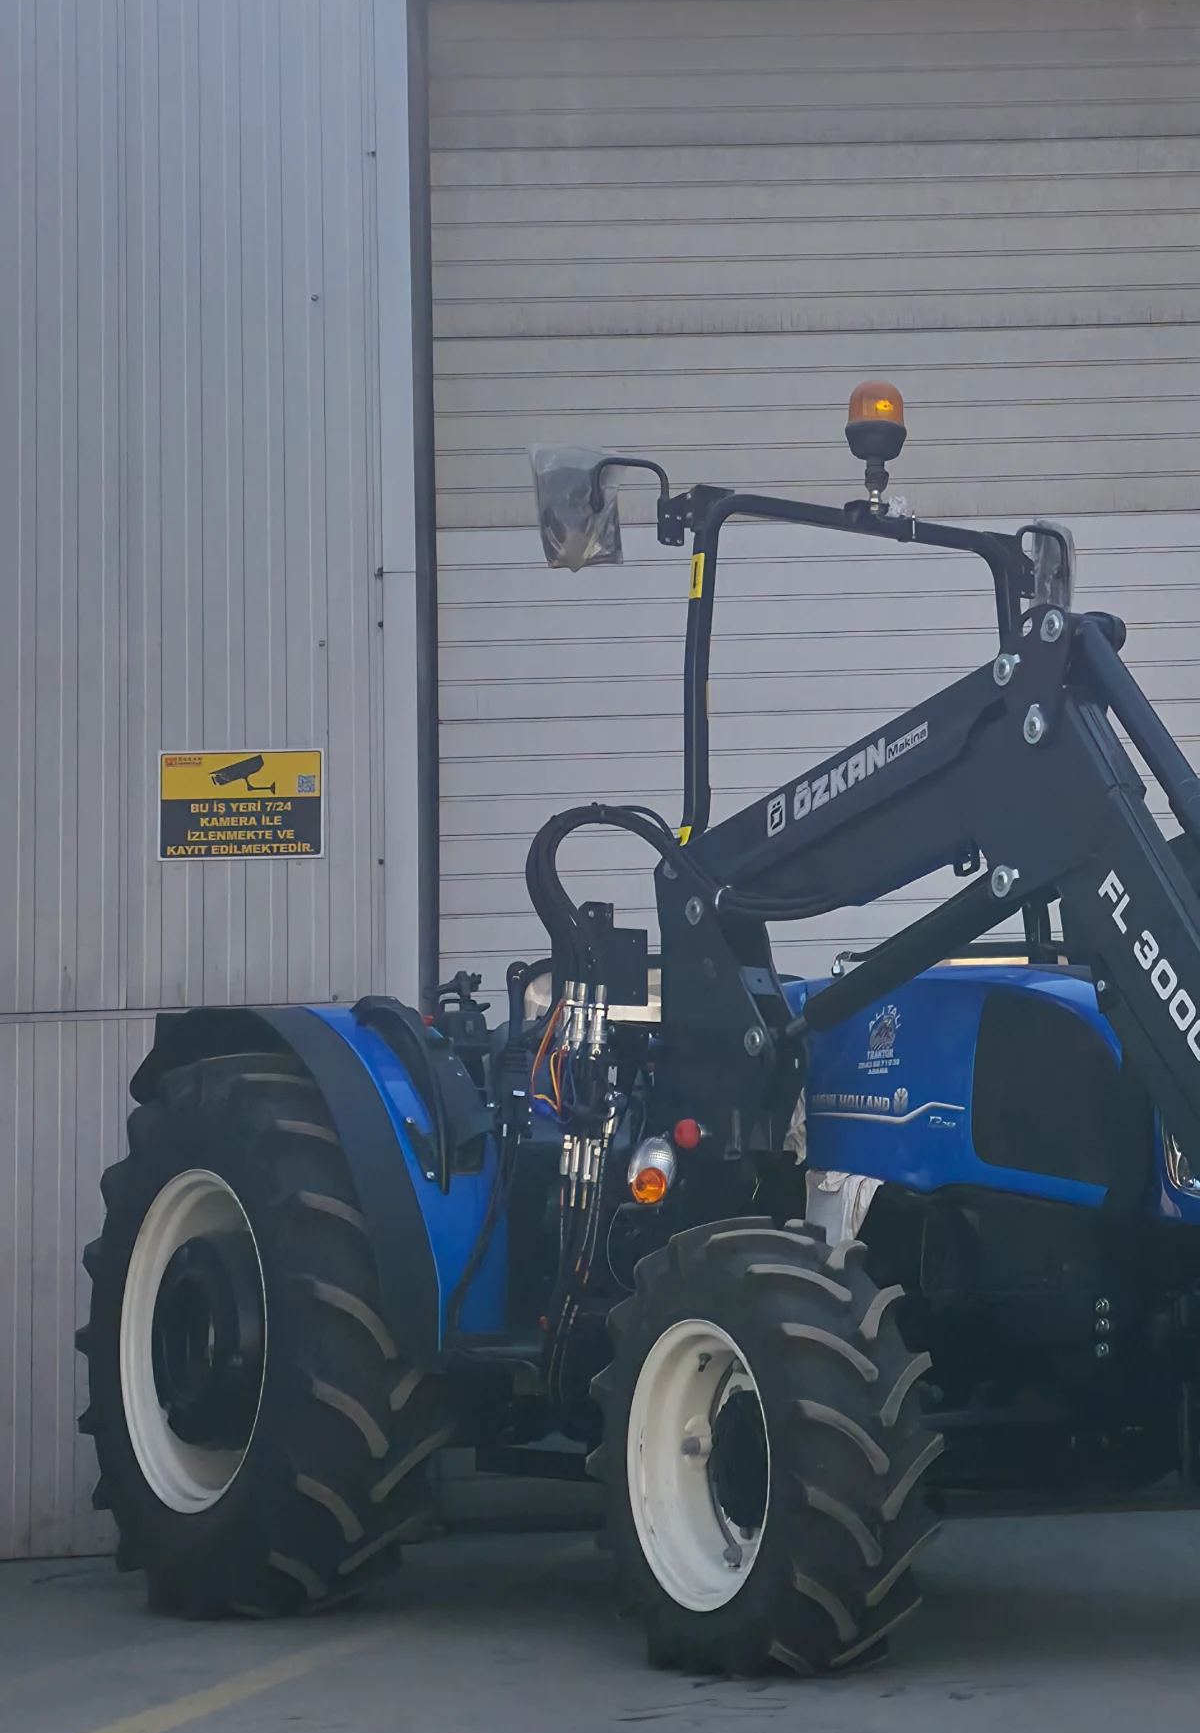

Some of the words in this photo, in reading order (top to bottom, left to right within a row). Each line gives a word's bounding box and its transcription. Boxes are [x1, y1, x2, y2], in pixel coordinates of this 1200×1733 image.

[794, 737, 886, 820] ÖZKAN
[888, 727, 927, 759] Makina
[190, 803, 208, 813] BU
[213, 801, 226, 815] İŞ
[230, 800, 261, 812] YERİ
[264, 801, 292, 811] 7/24
[200, 816, 257, 827] KAMERA
[261, 814, 282, 826] İLE
[187, 829, 273, 841] İZLENMEKTE
[277, 829, 295, 839] VE
[166, 845, 208, 856] KAYIT
[211, 841, 314, 855] EDİLMEKTEDİR.
[1097, 870, 1131, 935] FL
[839, 1094, 890, 1110] HOLLAND
